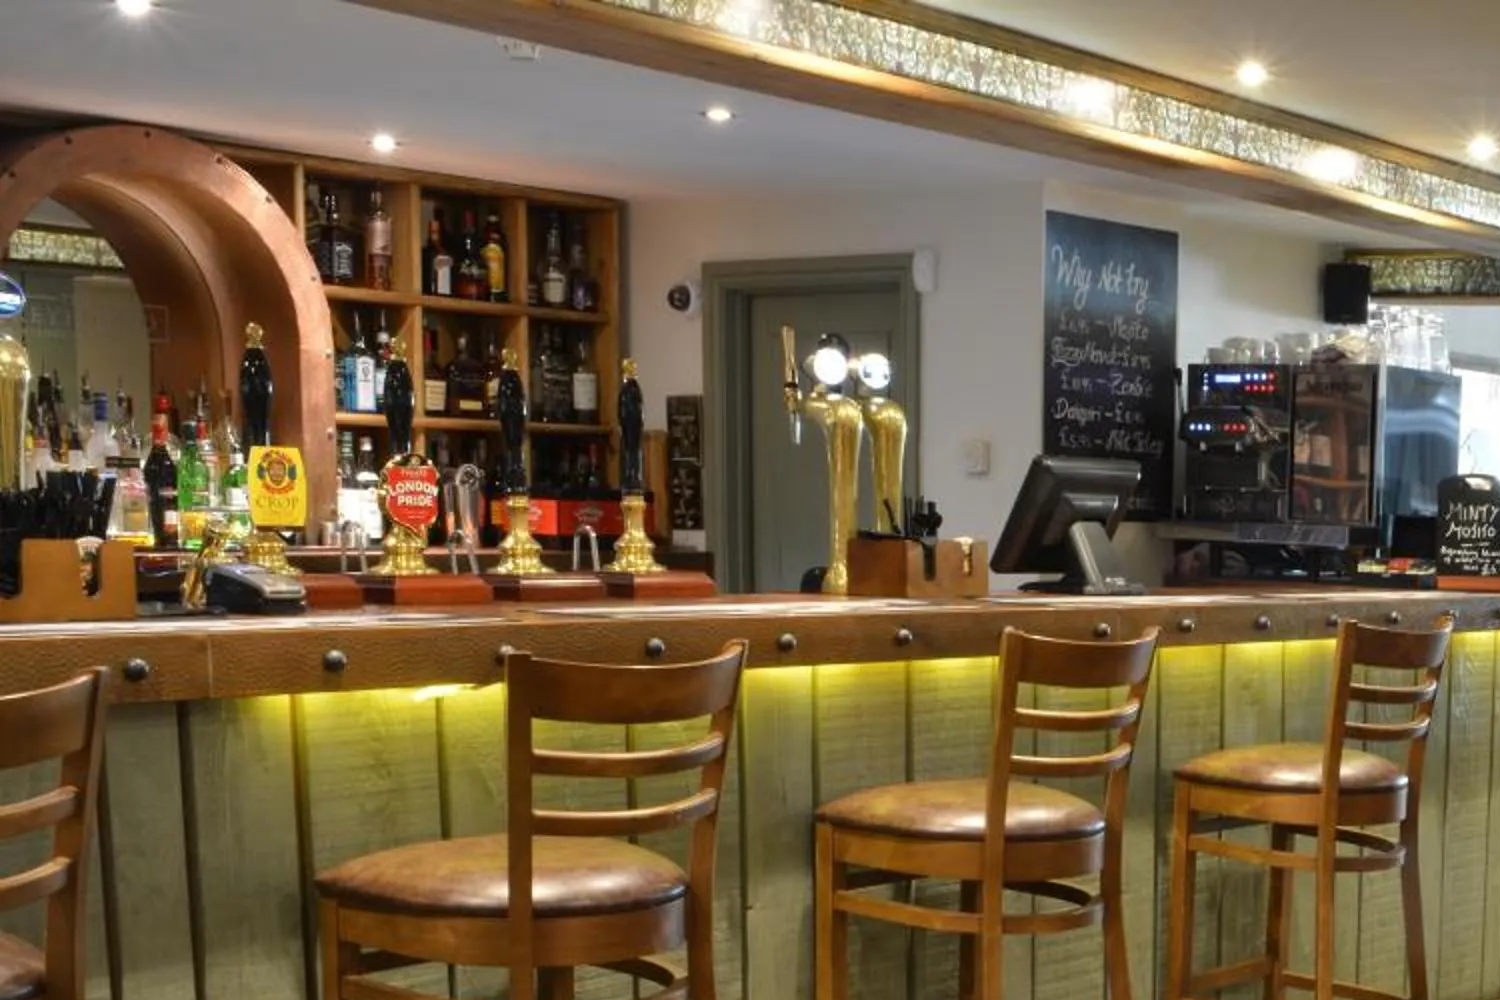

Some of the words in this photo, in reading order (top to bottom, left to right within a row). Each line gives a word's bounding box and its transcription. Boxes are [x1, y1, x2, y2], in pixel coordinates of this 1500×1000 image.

[1051, 244, 1092, 311] Why
[389, 481, 439, 497] LONDON
[397, 496, 433, 507] PRIDE
[1445, 502, 1500, 522] MINTY
